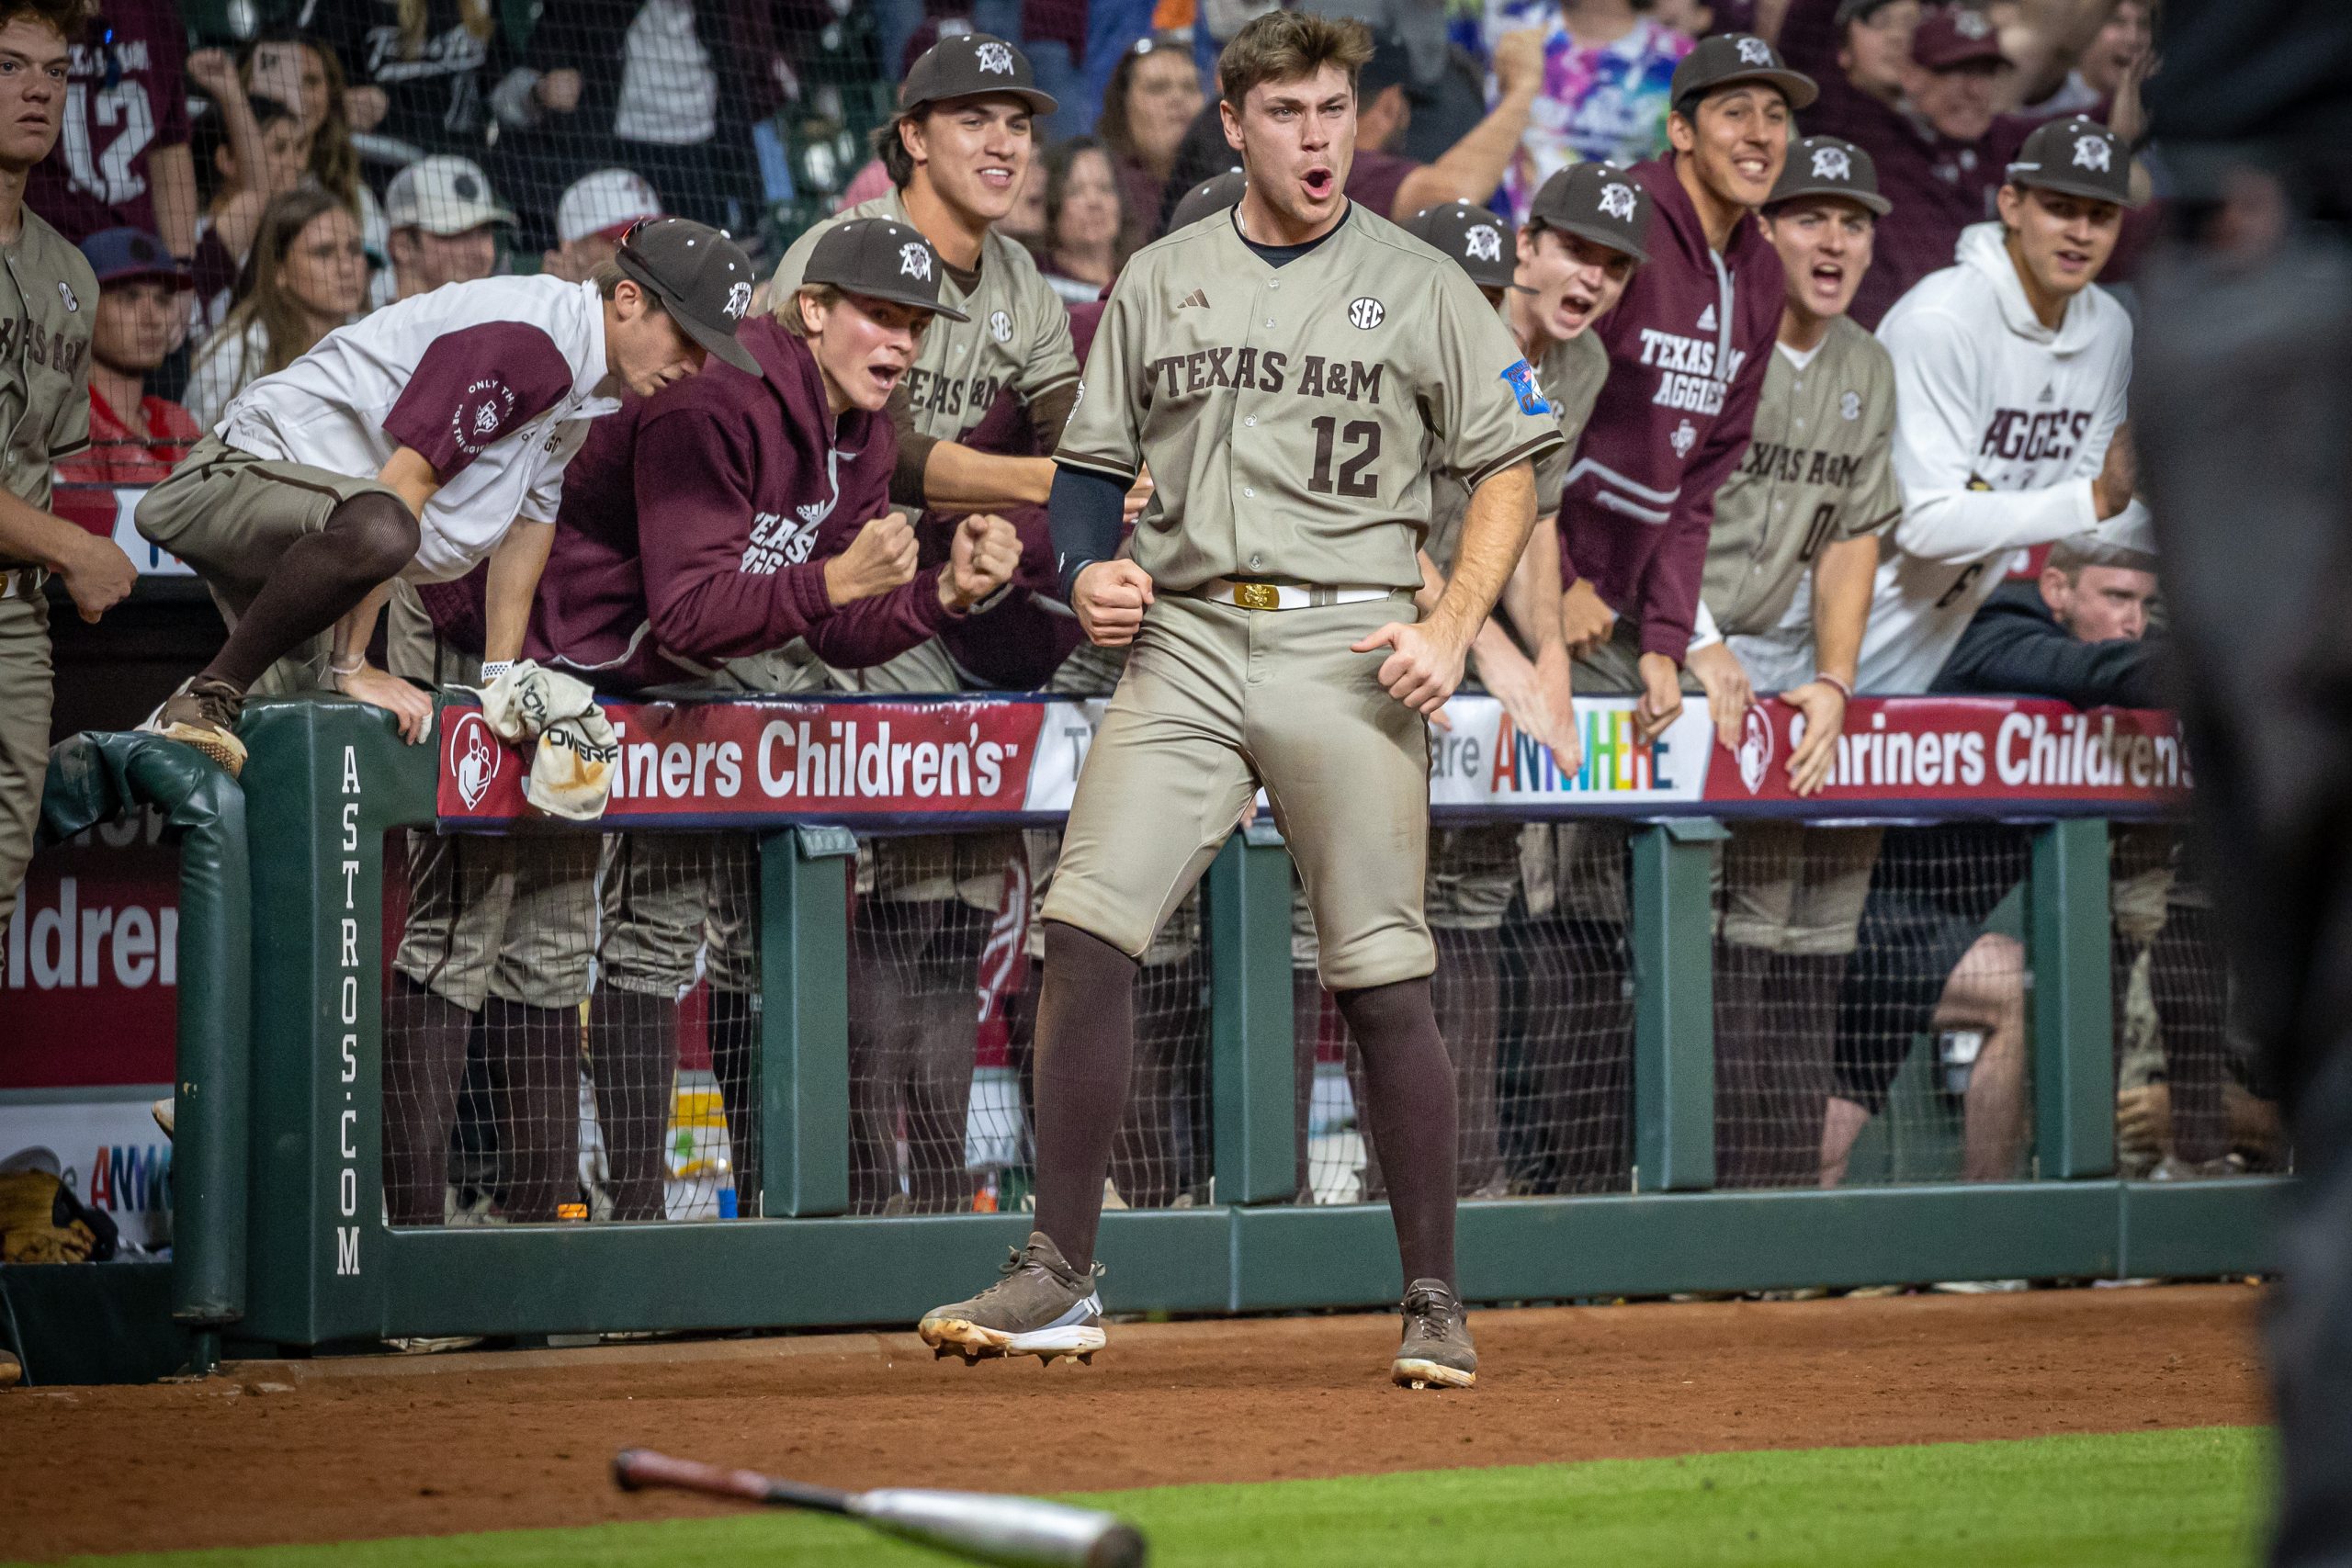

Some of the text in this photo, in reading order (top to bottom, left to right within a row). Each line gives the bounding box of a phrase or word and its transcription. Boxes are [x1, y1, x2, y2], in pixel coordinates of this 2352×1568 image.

[62, 79, 154, 206] 12
[1349, 298, 1385, 330] SEC
[1158, 346, 1385, 404] TEXAS A&M
[1640, 328, 1716, 378] TEXAS
[469, 379, 498, 393] ONLY
[1307, 415, 1382, 499] 12
[1430, 736, 1480, 778] are
